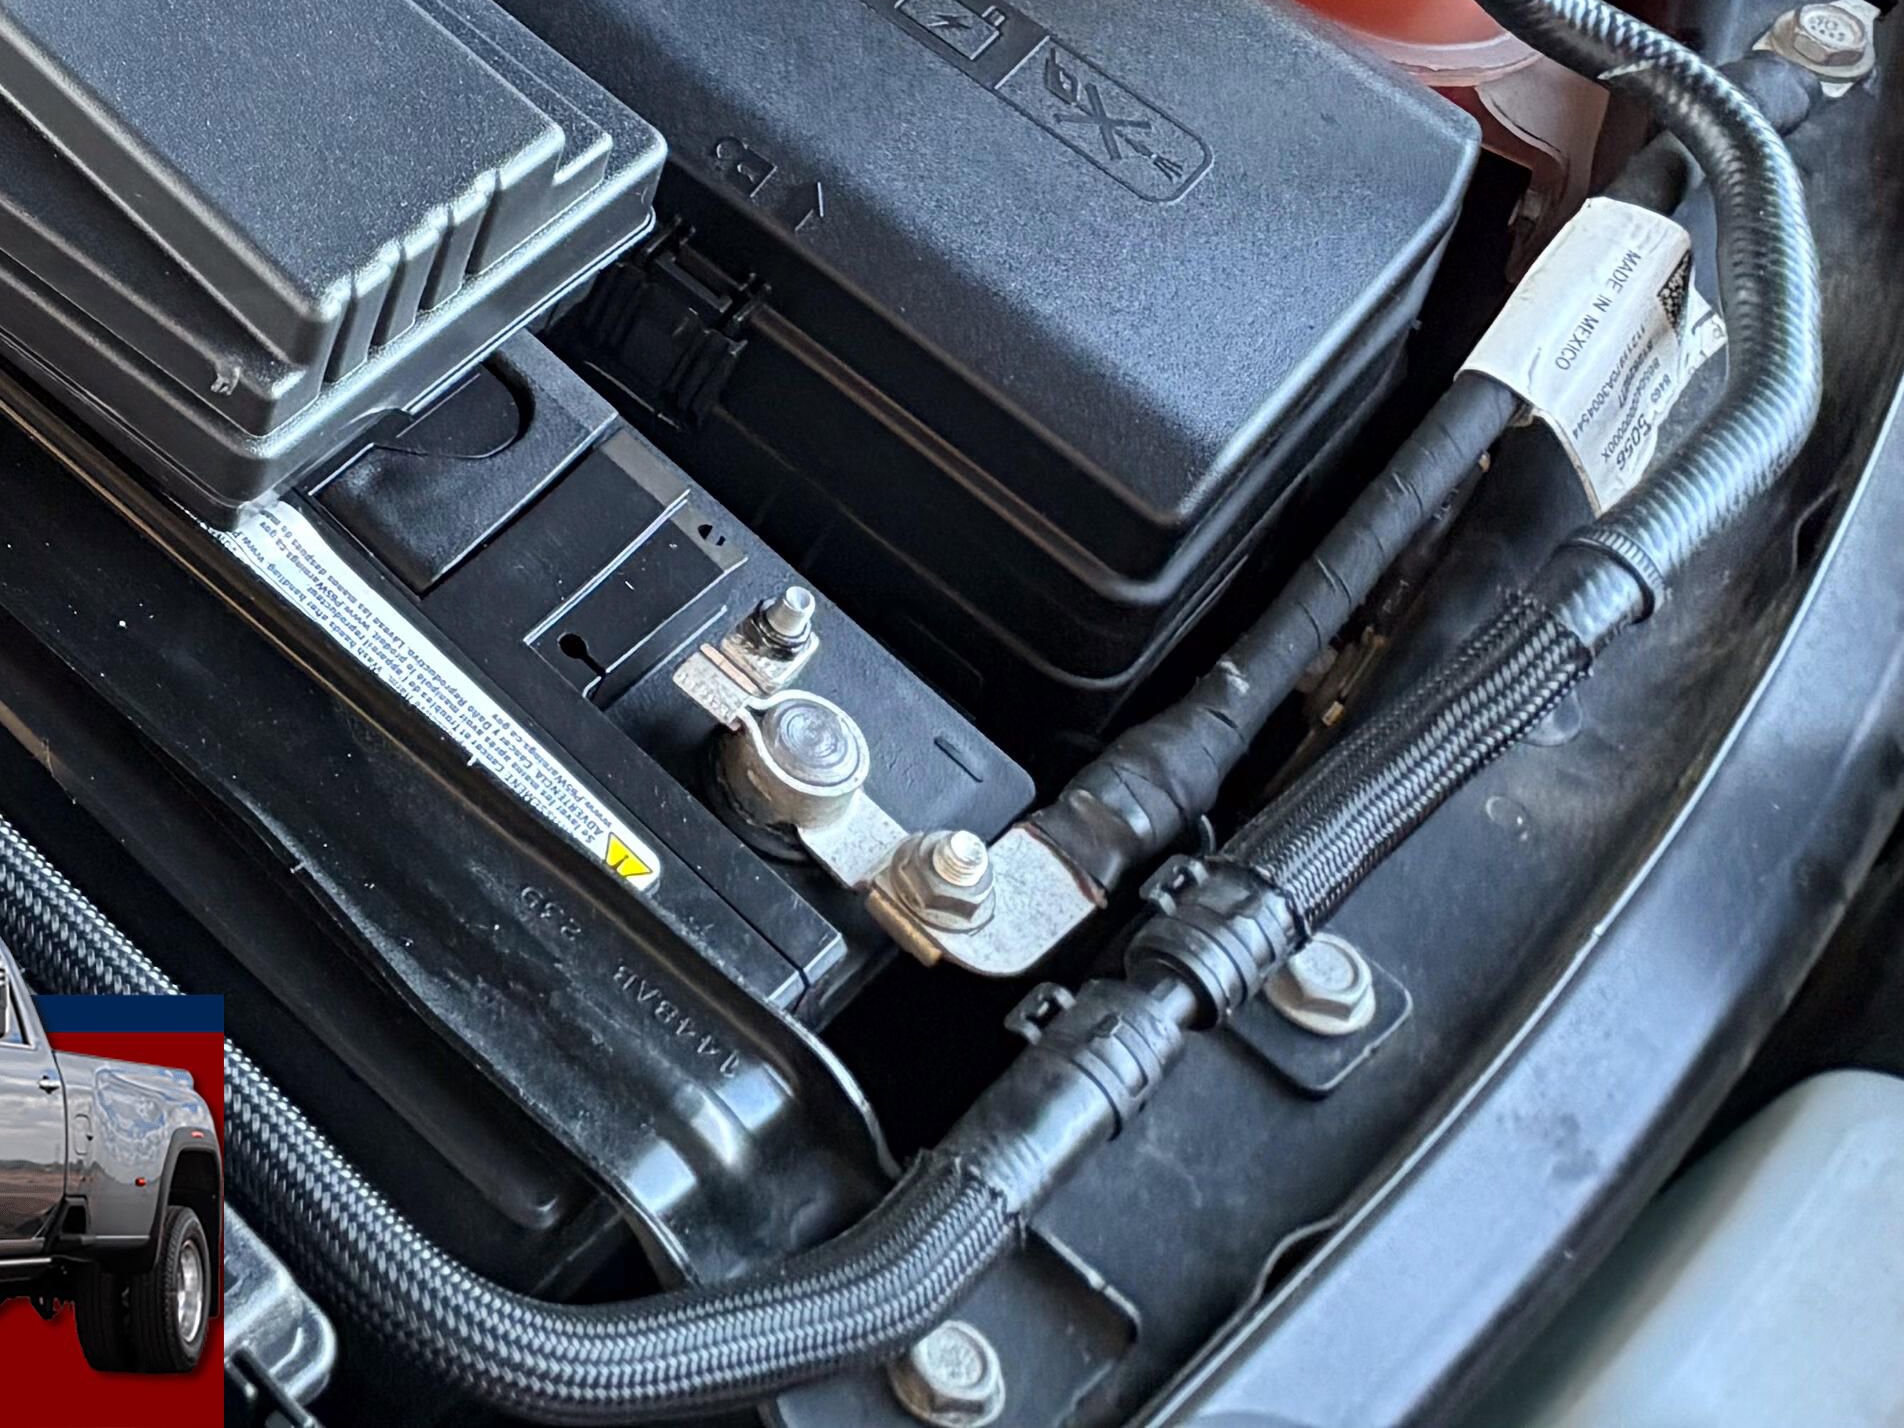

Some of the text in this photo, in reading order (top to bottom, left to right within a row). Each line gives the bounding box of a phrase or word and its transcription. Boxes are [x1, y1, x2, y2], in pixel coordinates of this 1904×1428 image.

[1552, 248, 1641, 373] MADE IN MEXICO
[1609, 413, 1655, 472] 5056
